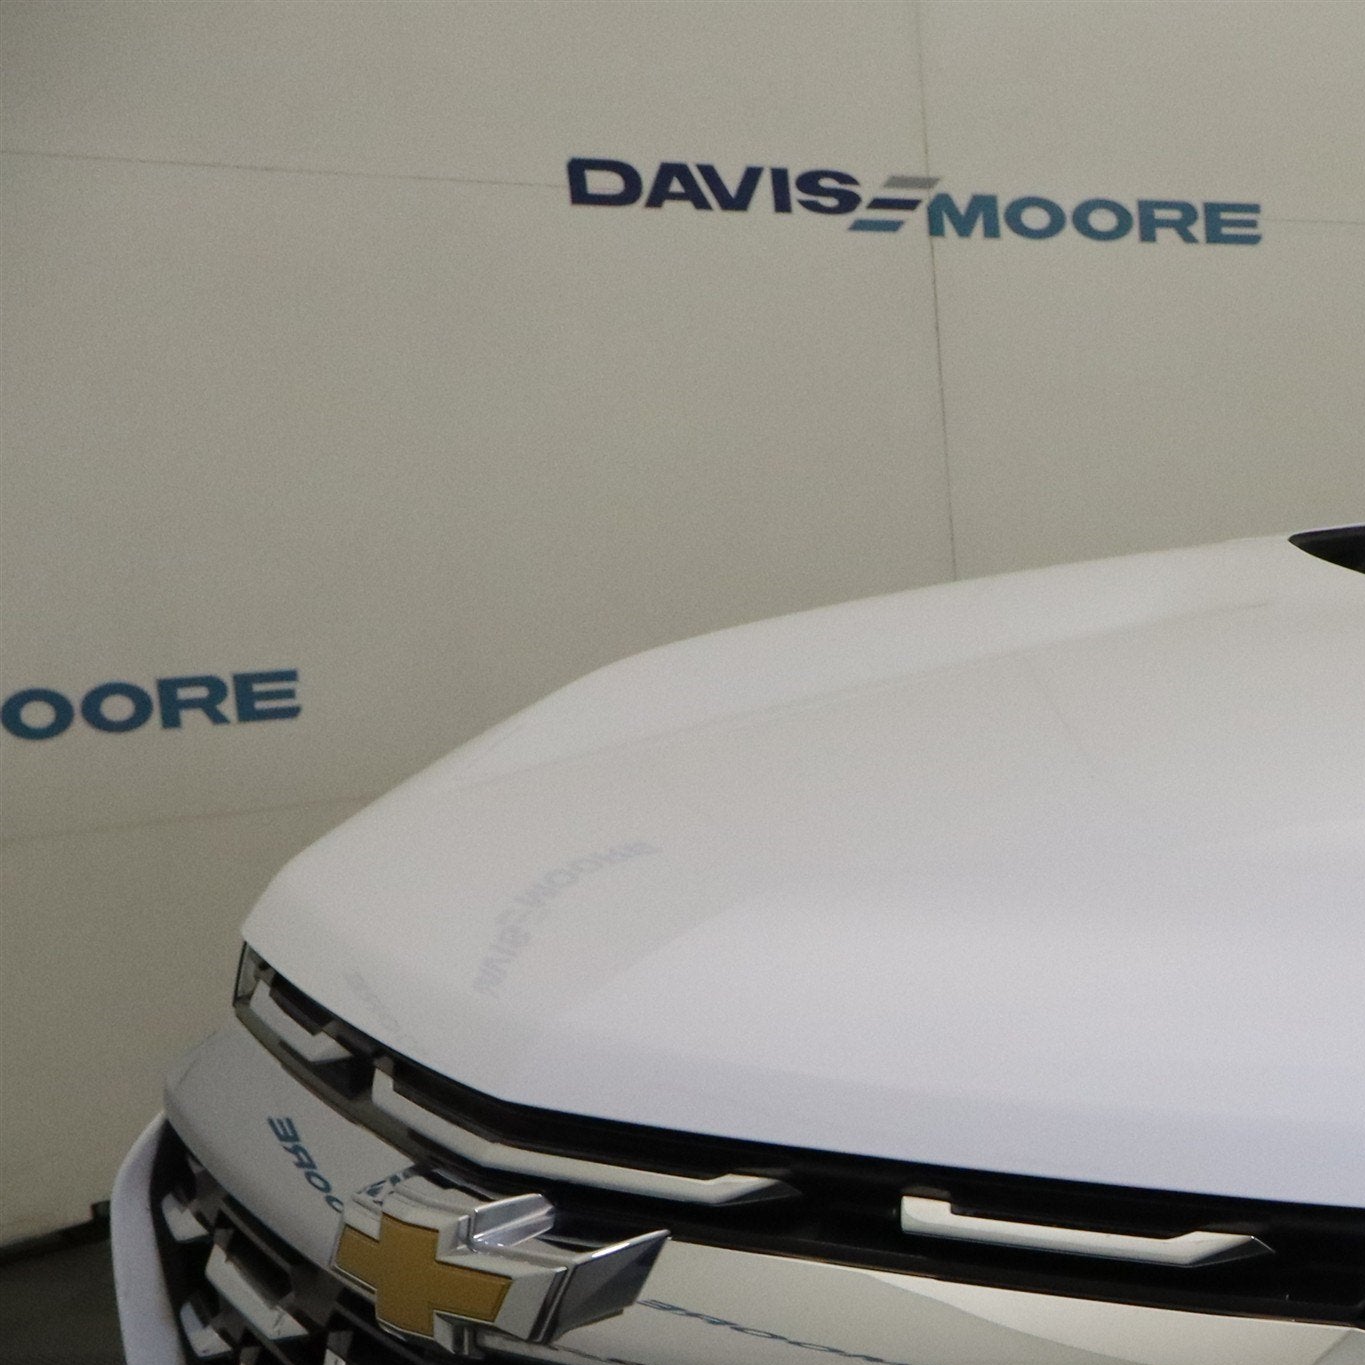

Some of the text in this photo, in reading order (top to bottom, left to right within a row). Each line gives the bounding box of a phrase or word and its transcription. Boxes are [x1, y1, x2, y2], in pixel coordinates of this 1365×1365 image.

[566, 157, 1262, 245] DAVIS MOORE
[0, 668, 302, 741] OORE
